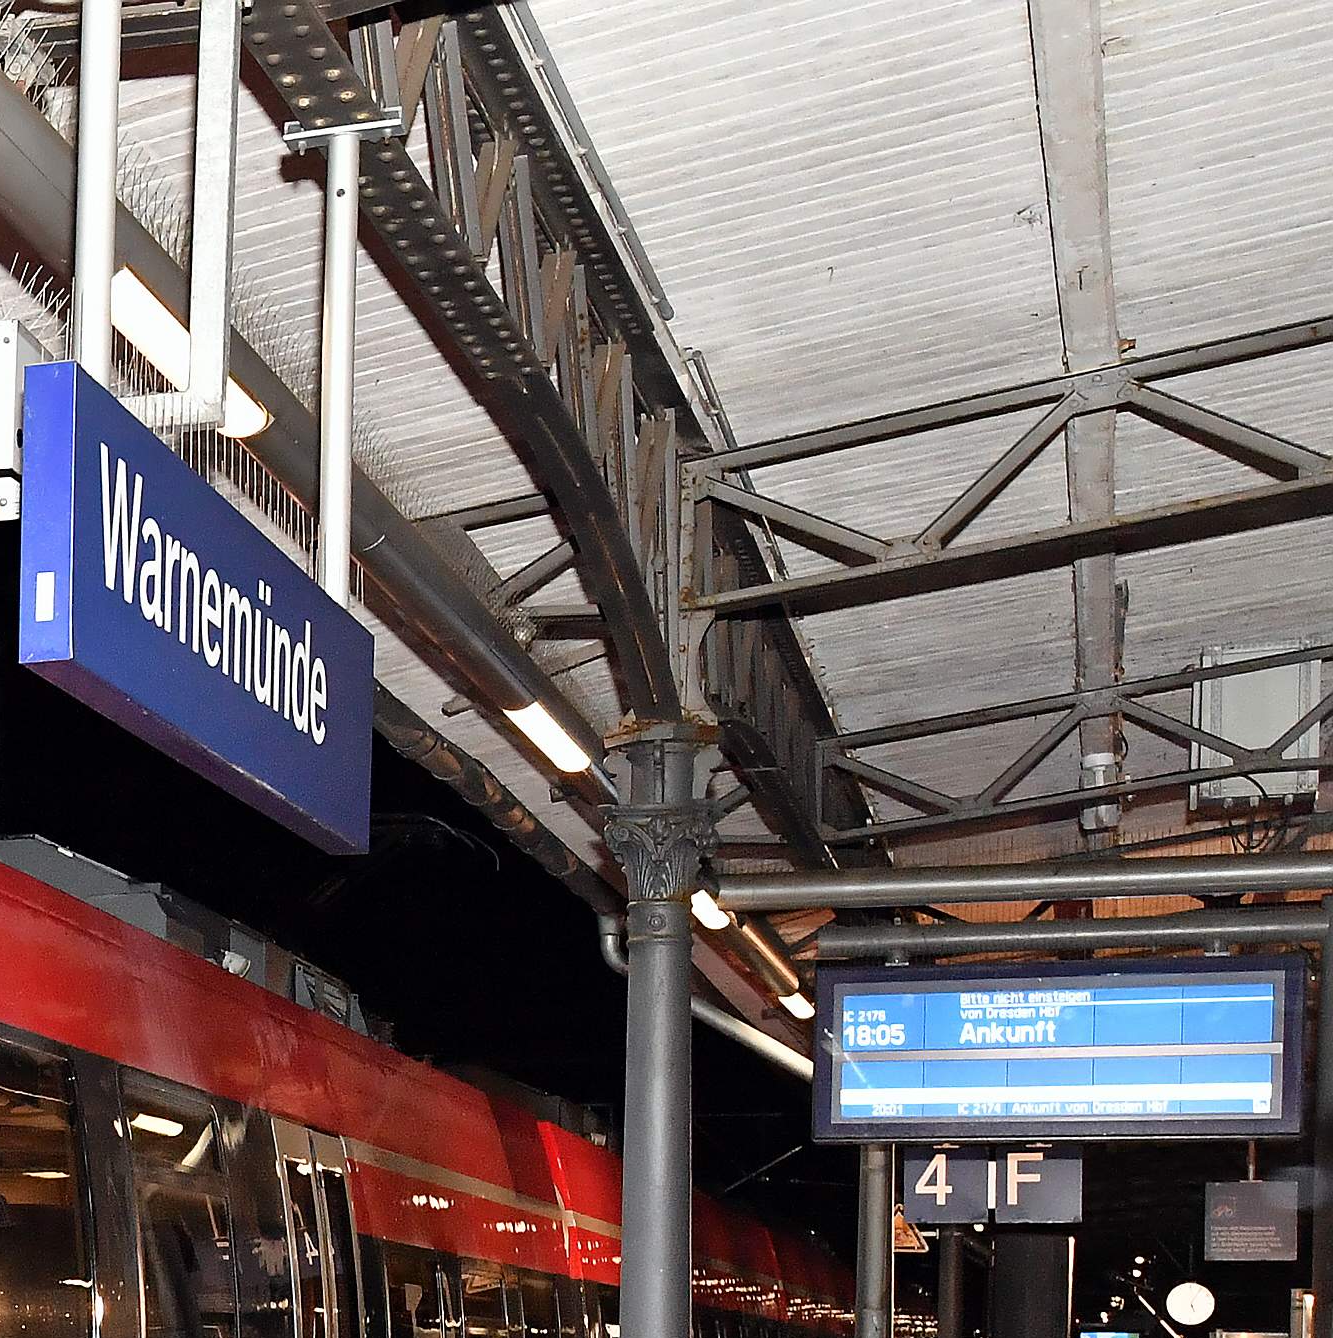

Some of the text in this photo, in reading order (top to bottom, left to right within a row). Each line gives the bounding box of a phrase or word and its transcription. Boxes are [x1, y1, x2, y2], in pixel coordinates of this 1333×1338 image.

[100, 442, 327, 745] Warnemünde
[959, 990, 1091, 1004] Bitte nicht einsteigen
[843, 1011, 854, 1022] IC
[960, 1009, 983, 1019] von
[986, 1007, 1036, 1019] Dresden
[844, 1023, 906, 1046] 18:05
[959, 1020, 1057, 1044] Ankunft
[871, 1104, 904, 1116] 20:01
[957, 1103, 967, 1115] IC
[1012, 1101, 1062, 1114] Ankunft
[1065, 1102, 1089, 1114] von
[1092, 1100, 1143, 1114] Dresden
[914, 1153, 953, 1206] 4
[1006, 1152, 1044, 1206] F
